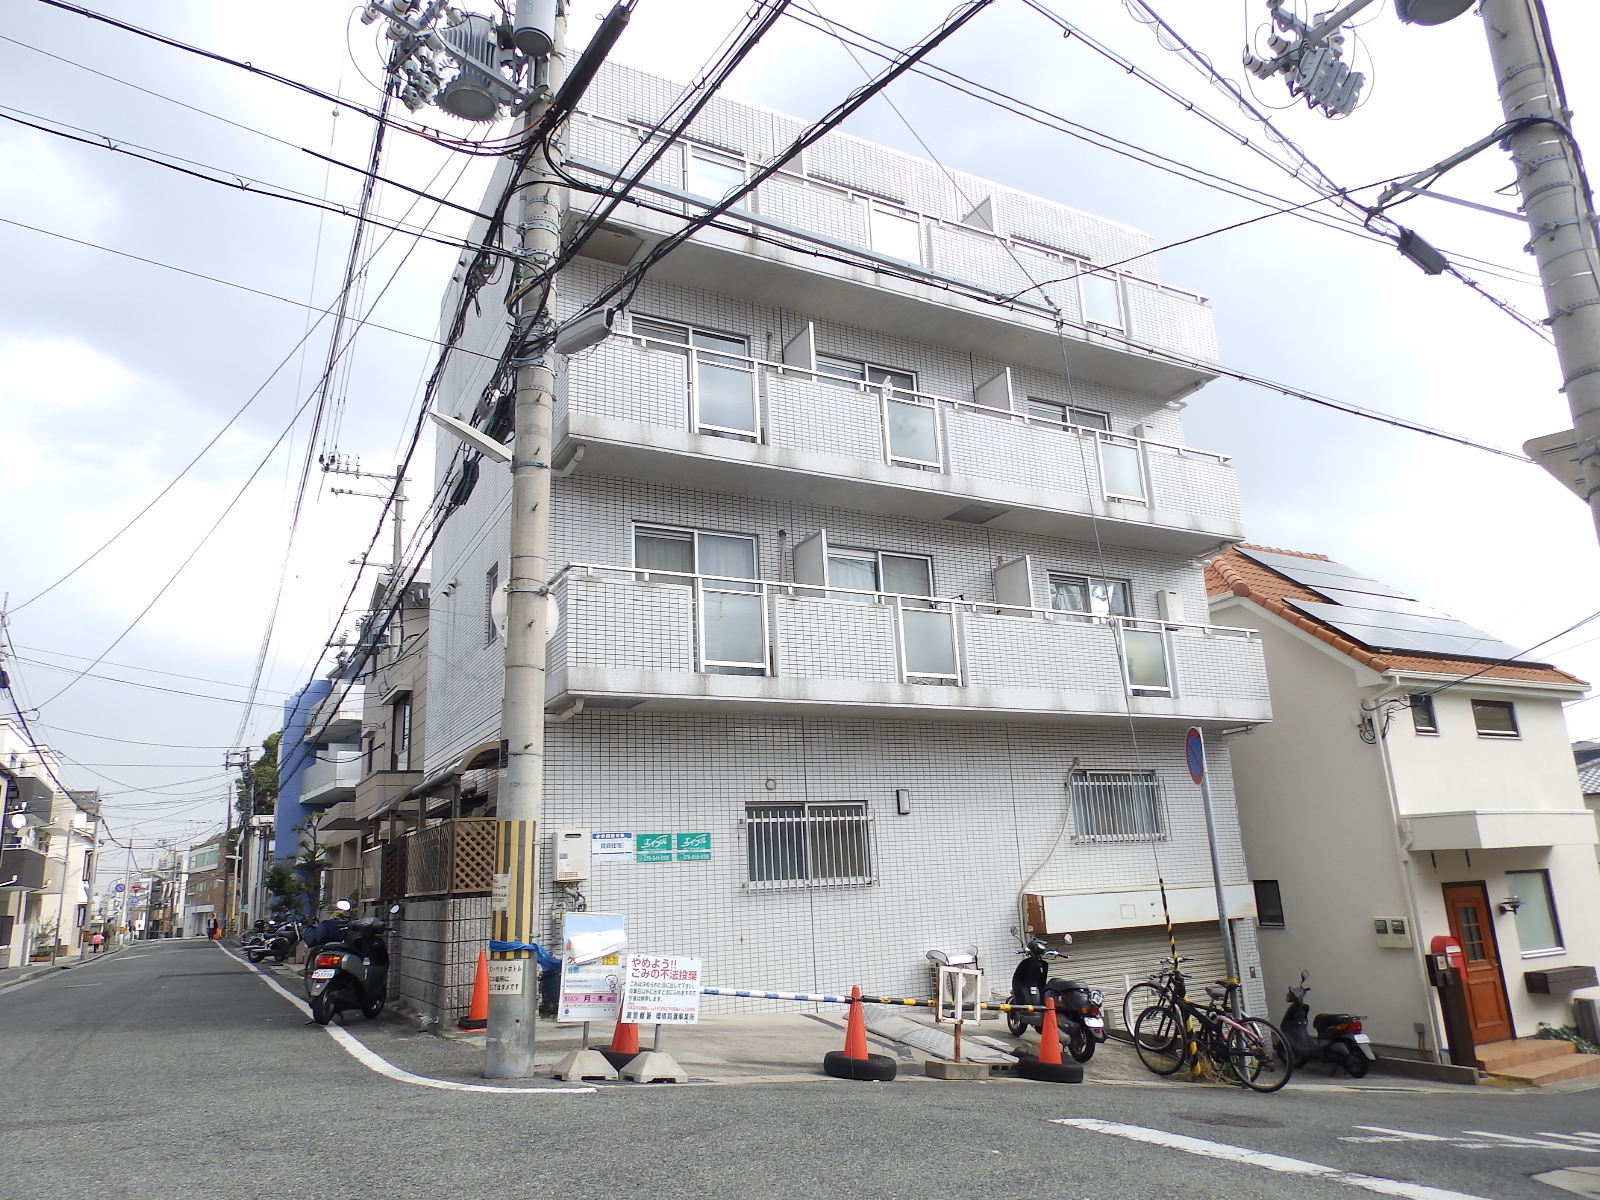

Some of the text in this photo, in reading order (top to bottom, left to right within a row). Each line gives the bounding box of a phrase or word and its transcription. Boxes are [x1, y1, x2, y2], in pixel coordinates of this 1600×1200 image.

[631, 957, 677, 969] やめよう!!
[631, 968, 698, 981] ごみの不法投棄
